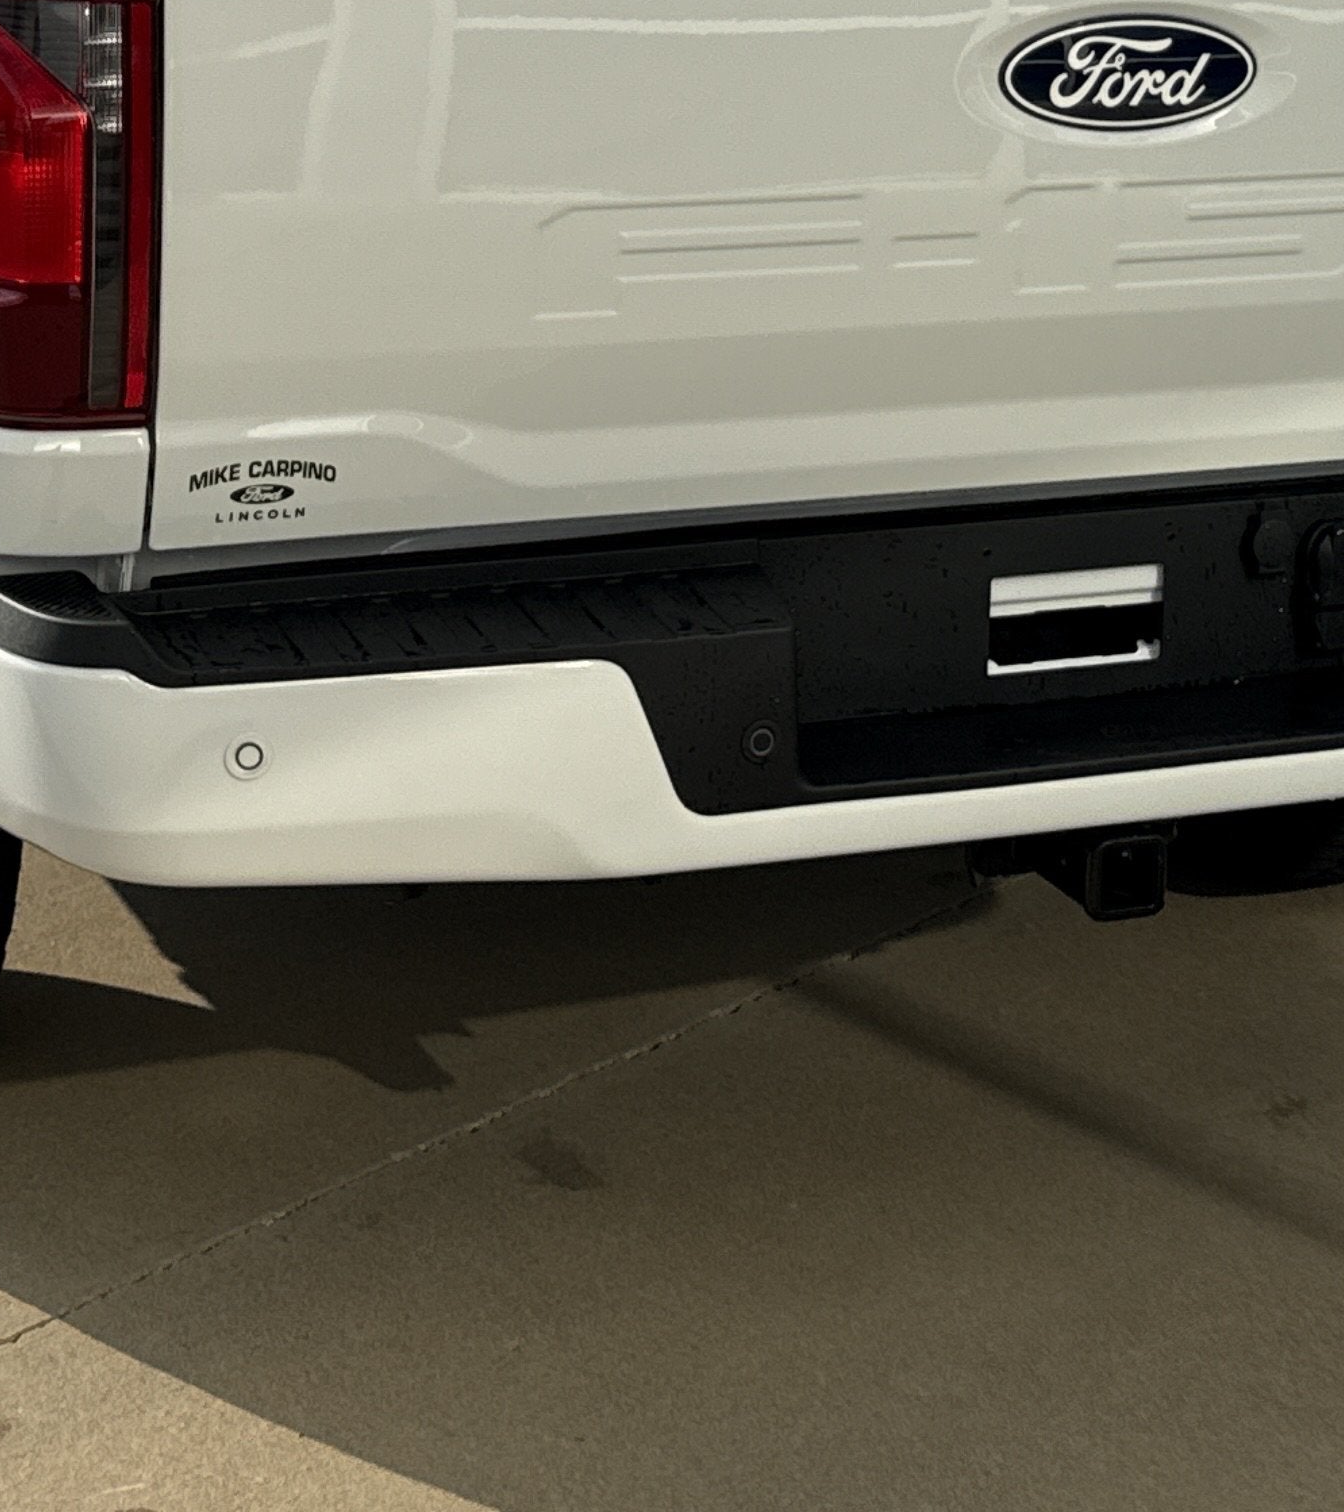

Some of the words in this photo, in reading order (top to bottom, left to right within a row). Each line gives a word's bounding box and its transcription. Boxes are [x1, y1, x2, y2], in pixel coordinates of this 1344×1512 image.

[1049, 35, 1212, 109] Ford
[188, 462, 242, 492] MIKE
[248, 459, 337, 483] CARPINO
[215, 506, 306, 524] LINCOLN
